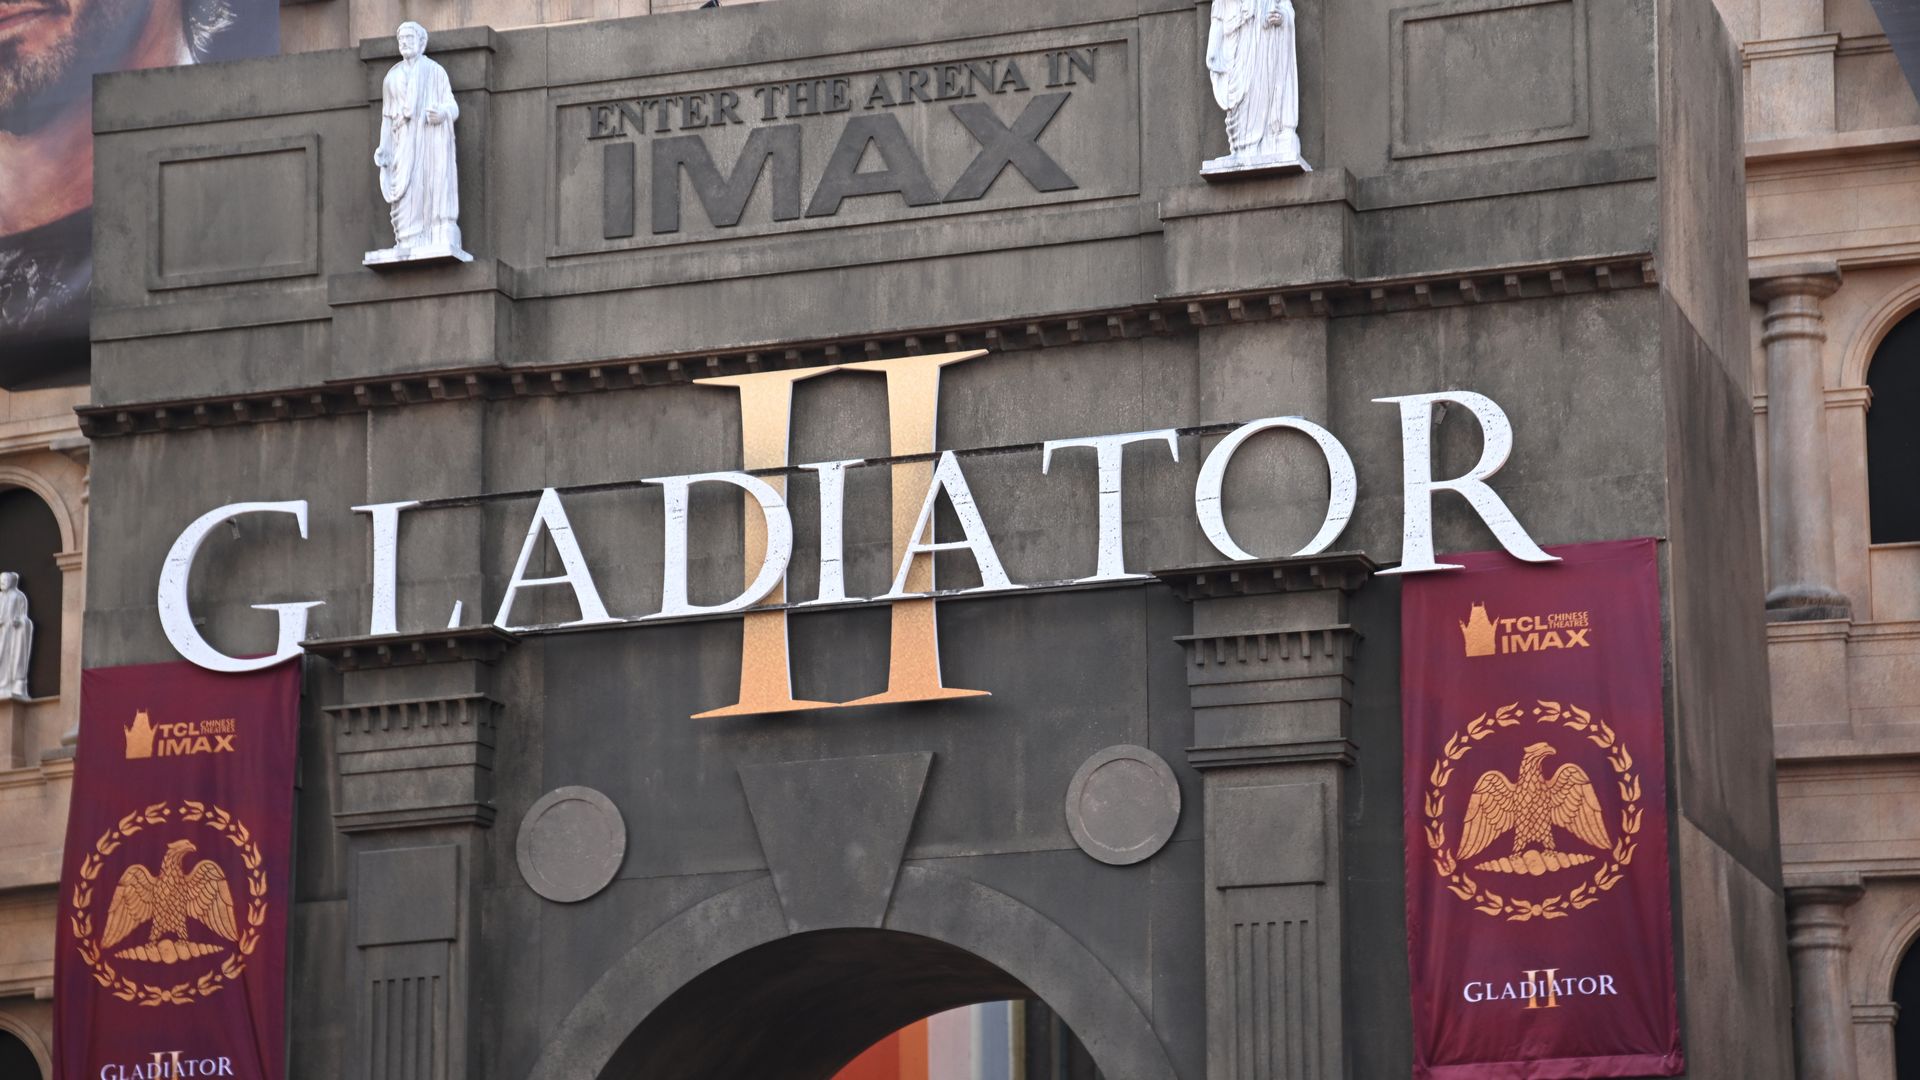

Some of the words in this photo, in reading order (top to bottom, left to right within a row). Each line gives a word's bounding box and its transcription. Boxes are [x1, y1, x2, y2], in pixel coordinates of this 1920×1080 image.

[587, 91, 743, 140] ENTER
[755, 78, 851, 121] THE
[864, 59, 1030, 110] ARENA
[1043, 47, 1098, 88] IN
[603, 92, 1079, 239] IMAX
[158, 390, 1563, 673] GLADIATOR
[1501, 615, 1548, 633] TCL
[1548, 611, 1589, 622] CHINESE
[1549, 618, 1589, 630] THEATRES
[1502, 628, 1590, 654] IMAX
[159, 722, 200, 738] TCL
[200, 718, 236, 728] CHINESE
[157, 734, 236, 757] IMAX
[1463, 974, 1618, 1003] GLADIATOR
[100, 1056, 234, 1080] GLADIATOR
